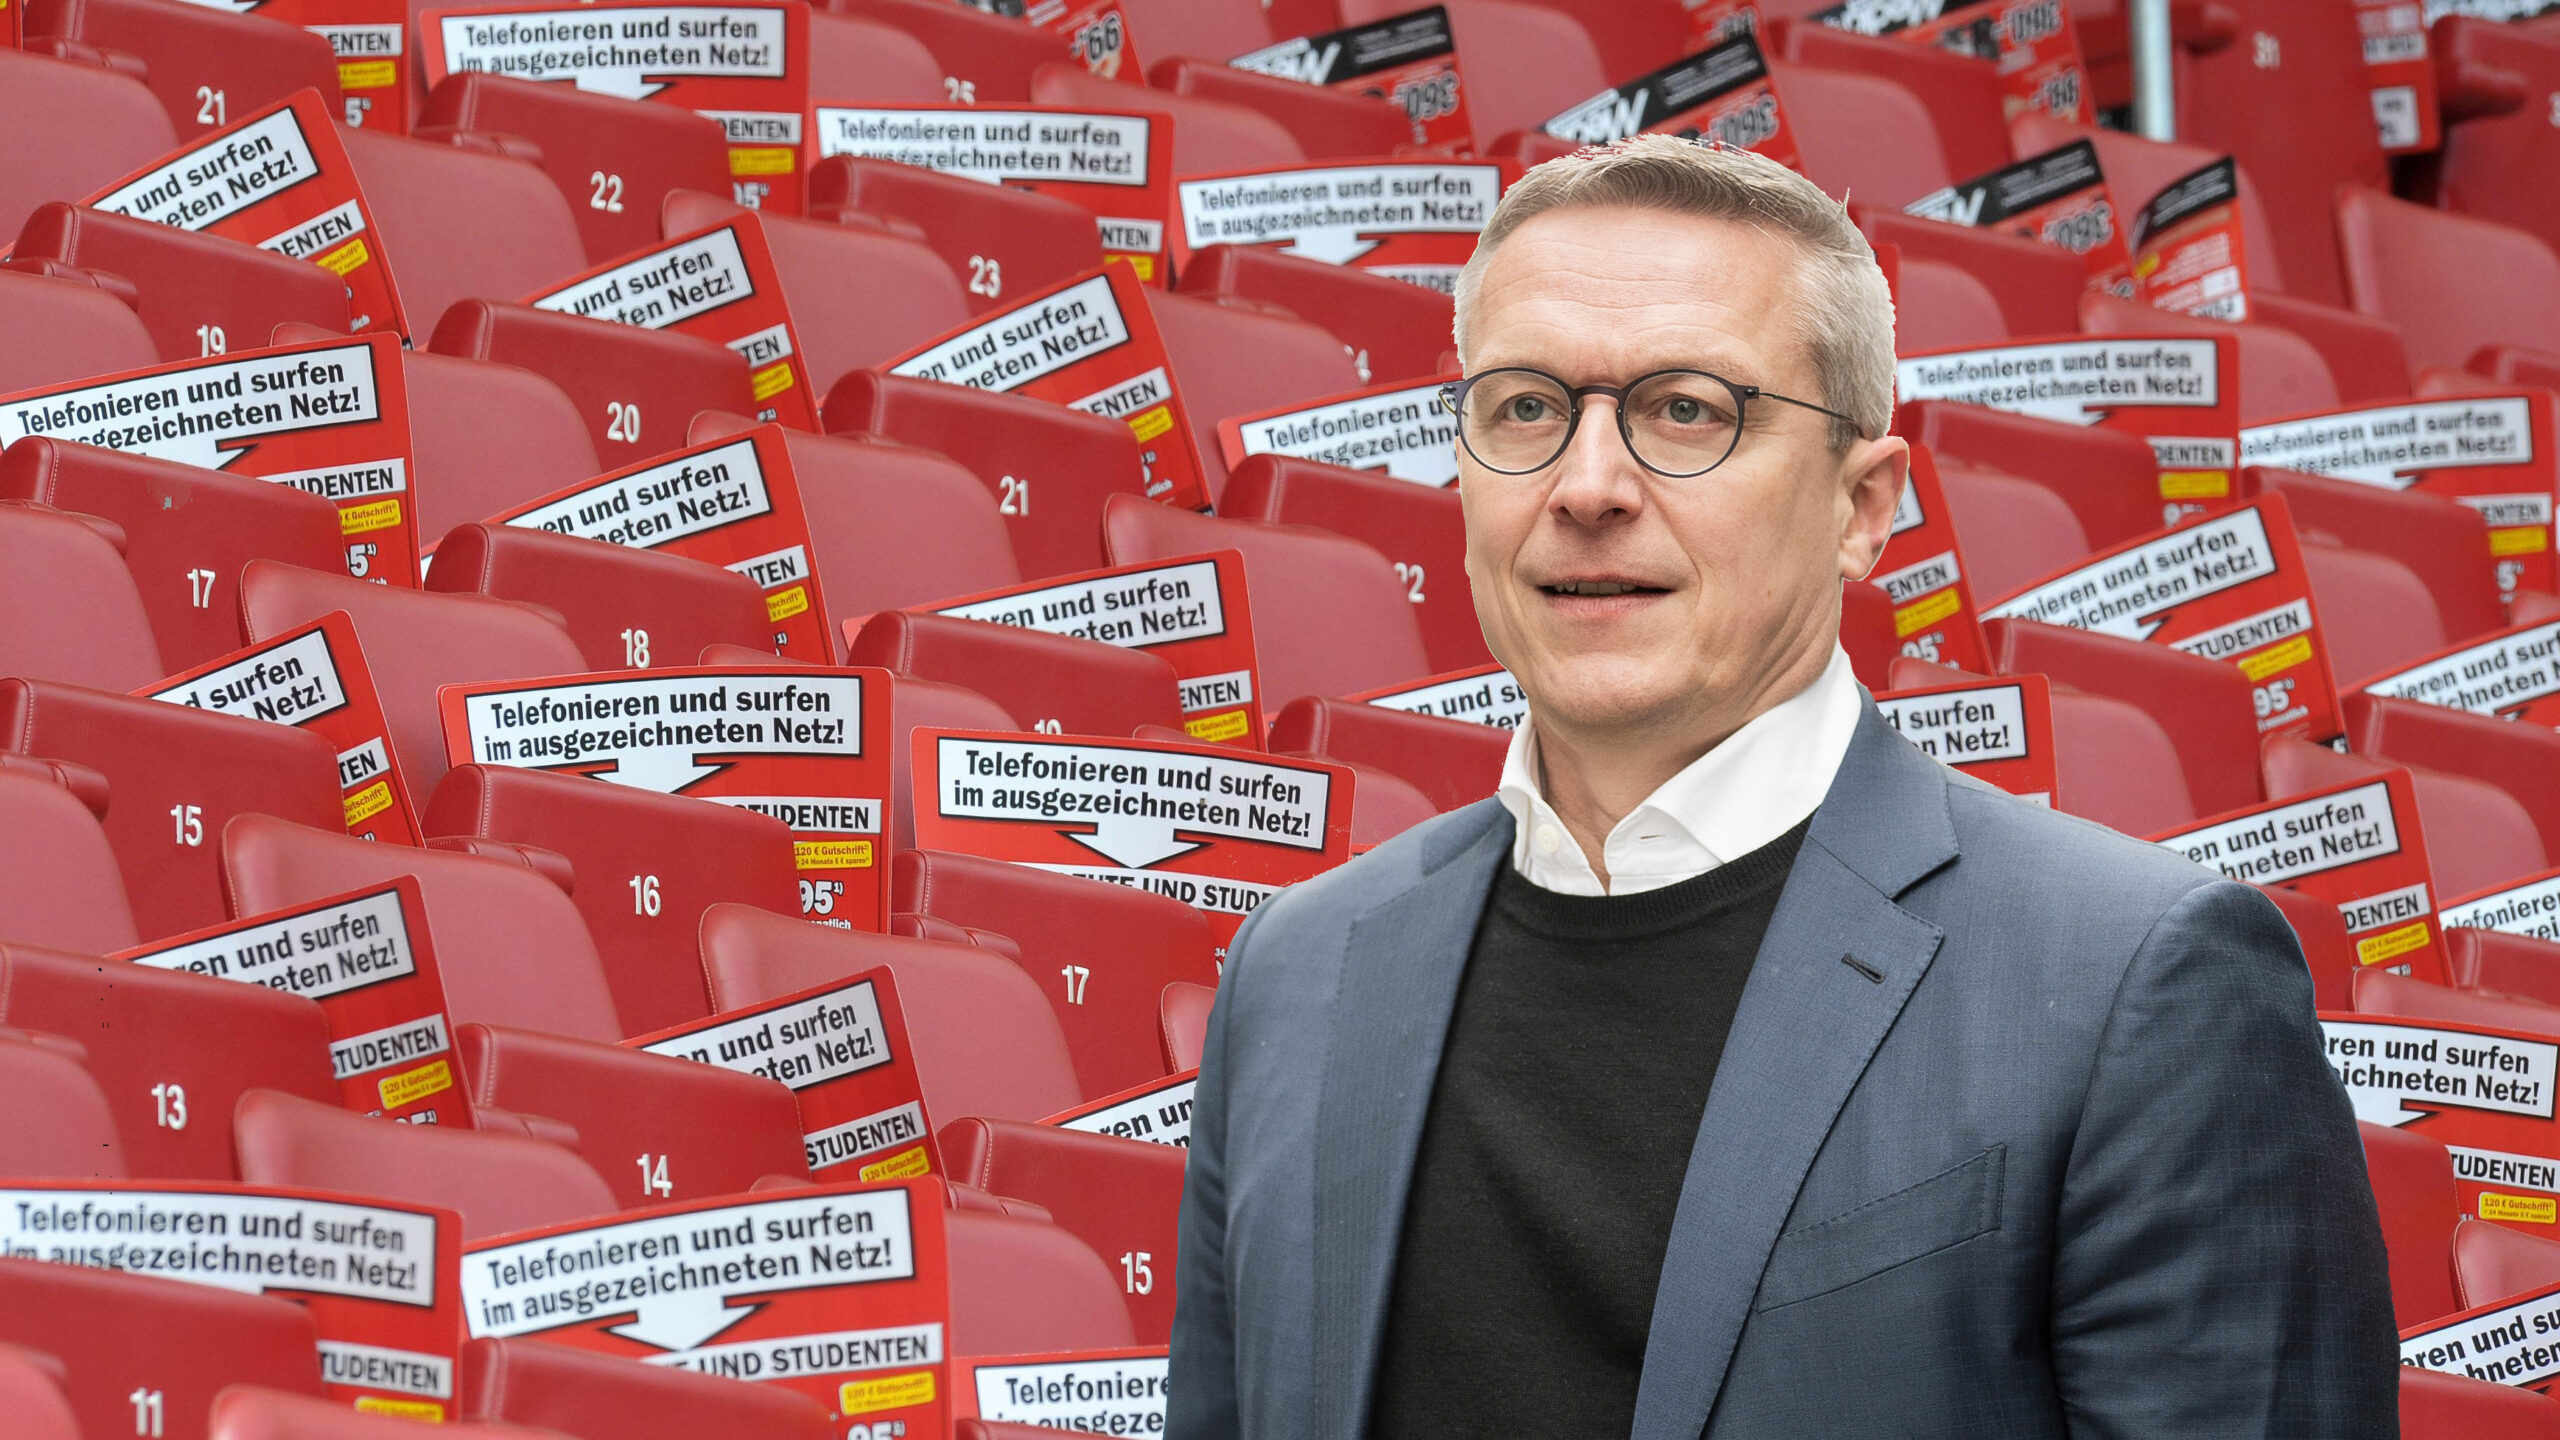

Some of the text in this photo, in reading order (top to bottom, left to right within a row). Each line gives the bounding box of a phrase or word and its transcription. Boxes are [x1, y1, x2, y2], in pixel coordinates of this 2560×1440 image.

[332, 33, 391, 53] ENTEN
[466, 17, 758, 46] Telefonieren und surfen
[459, 45, 769, 75] im ausgezeichneten Netz!
[197, 86, 226, 126] 21
[718, 119, 789, 139] DENTEN
[838, 118, 1120, 145] Telefonieren und surfen
[135, 175, 183, 216] und
[187, 135, 273, 187] surfen
[230, 151, 298, 199] Netz!
[870, 147, 1061, 171] gezeichneten
[1070, 154, 1131, 175] Netz!
[590, 171, 624, 213] 22
[1200, 174, 1471, 210] Telefonieren und surfen
[274, 212, 353, 260] DENTEN
[1195, 200, 1484, 237] im ausgezeichneten Netz!
[575, 284, 621, 316] und
[628, 251, 714, 294] surfen
[668, 269, 734, 310] Netz!
[968, 256, 1000, 298] 23
[197, 325, 226, 357] 19
[952, 299, 1086, 370] und surfen
[1042, 316, 1109, 357] Netz!
[2063, 349, 2109, 371] und
[2115, 349, 2192, 368] surfen
[18, 363, 344, 435] Telefonieren und surfen
[1080, 381, 1158, 418] ENTEN
[2146, 376, 2202, 396] Netz!
[70, 387, 361, 450] gezeichneten Netz!
[607, 402, 640, 443] 20
[1265, 403, 1419, 450] Telefonieren
[2156, 444, 2223, 463] DENTEN
[282, 467, 394, 498] UDENTEN
[580, 462, 729, 526] und surfen
[1000, 476, 1029, 516] 21
[678, 483, 751, 525] Netz!
[2479, 503, 2542, 521] ENTEN
[2103, 529, 2239, 590] und surfen
[2193, 547, 2258, 584] Netz!
[187, 568, 216, 608] 17
[1043, 578, 1191, 622] und surfen
[1887, 563, 1947, 597] ENTEN
[1142, 602, 1207, 632] Netz!
[621, 628, 650, 668] 18
[2463, 629, 2560, 681] und surf
[210, 655, 304, 711] surfen
[254, 677, 326, 721] Netz!
[1179, 680, 1240, 709] ENTEN
[1441, 684, 1493, 716] und
[491, 685, 830, 729] Telefonieren und surfen
[1910, 703, 1995, 728] surfen
[484, 717, 844, 761] im ausgezeichneten Netz!
[1946, 726, 2009, 754] Netz!
[967, 750, 1301, 805] Telefonieren und surfen
[171, 805, 203, 846] 15
[739, 804, 869, 829] UDENTEN
[955, 781, 1311, 838] im ausgezeichneten Netz!
[2228, 801, 2365, 859] und surfen
[2323, 825, 2383, 858] Netz!
[795, 846, 812, 856] 120
[814, 846, 819, 856] €
[629, 875, 661, 916] 16
[1141, 877, 1197, 903] UND
[1202, 885, 1271, 913] STUDE
[2344, 894, 2419, 929] DENTEN
[236, 912, 380, 970] und surfen
[337, 938, 398, 979] Netz!
[1061, 965, 1090, 1005] 17
[720, 1002, 856, 1063] und surfen
[816, 1028, 874, 1070] Netz!
[2385, 1035, 2530, 1074] und surfen
[2337, 1065, 2540, 1105] ichneten Netz!
[152, 1083, 187, 1130] 13
[1159, 1098, 1194, 1128] un
[805, 1112, 917, 1166] STUDENTEN
[637, 1153, 673, 1198] 14
[2451, 1153, 2555, 1188] TUDENTEN
[2484, 1198, 2500, 1207] 120
[18, 1203, 404, 1252] Telefonieren und surfen
[488, 1207, 874, 1291] Telefonieren und surfen
[347, 1255, 416, 1290] Netz!
[482, 1238, 892, 1328] im ausgezeichneten Netz!
[1120, 1252, 1153, 1295] 15
[2475, 1315, 2526, 1354] und
[321, 1351, 438, 1390] TUDENTEN
[699, 1334, 928, 1378] UND STUDENTEN
[1006, 1370, 1169, 1405] Telefoniere
[129, 1387, 163, 1437] 11
